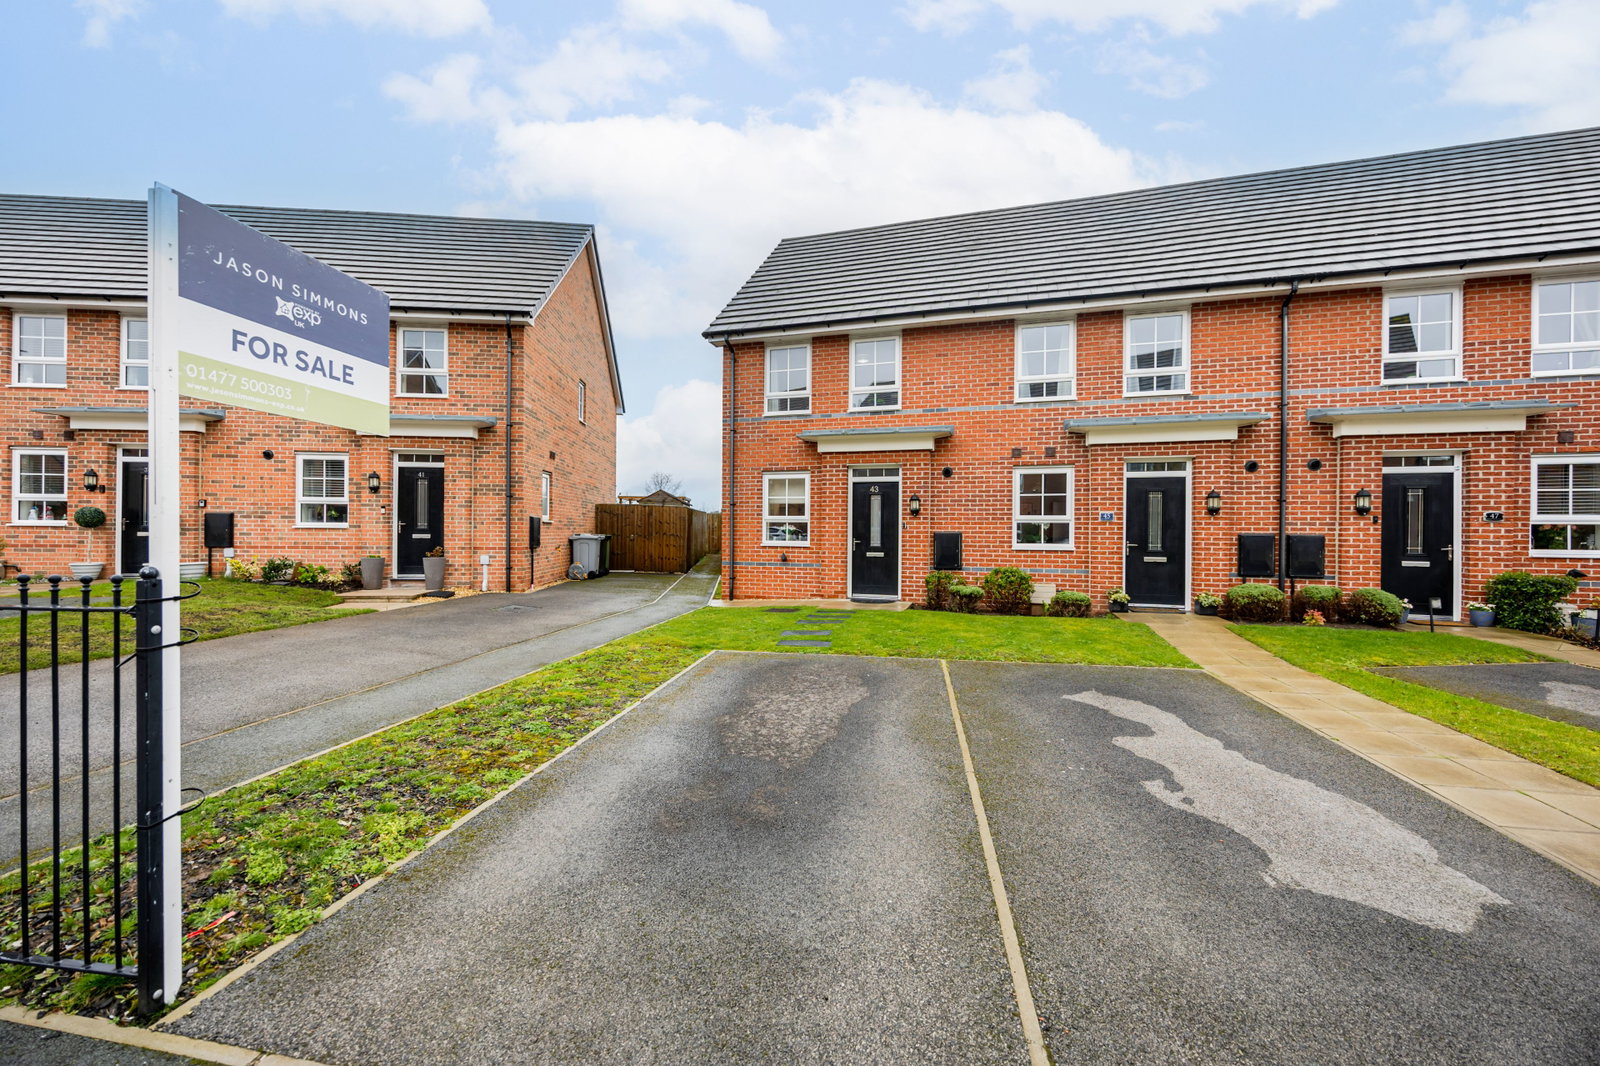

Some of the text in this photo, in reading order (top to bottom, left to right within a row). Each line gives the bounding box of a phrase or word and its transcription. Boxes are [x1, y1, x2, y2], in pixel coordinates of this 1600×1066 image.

[213, 252, 368, 325] JASON SIMMONS
[294, 320, 305, 329] UK
[231, 328, 355, 385] FOR SALE
[185, 363, 292, 400] 01477 500303
[869, 485, 879, 493] 43
